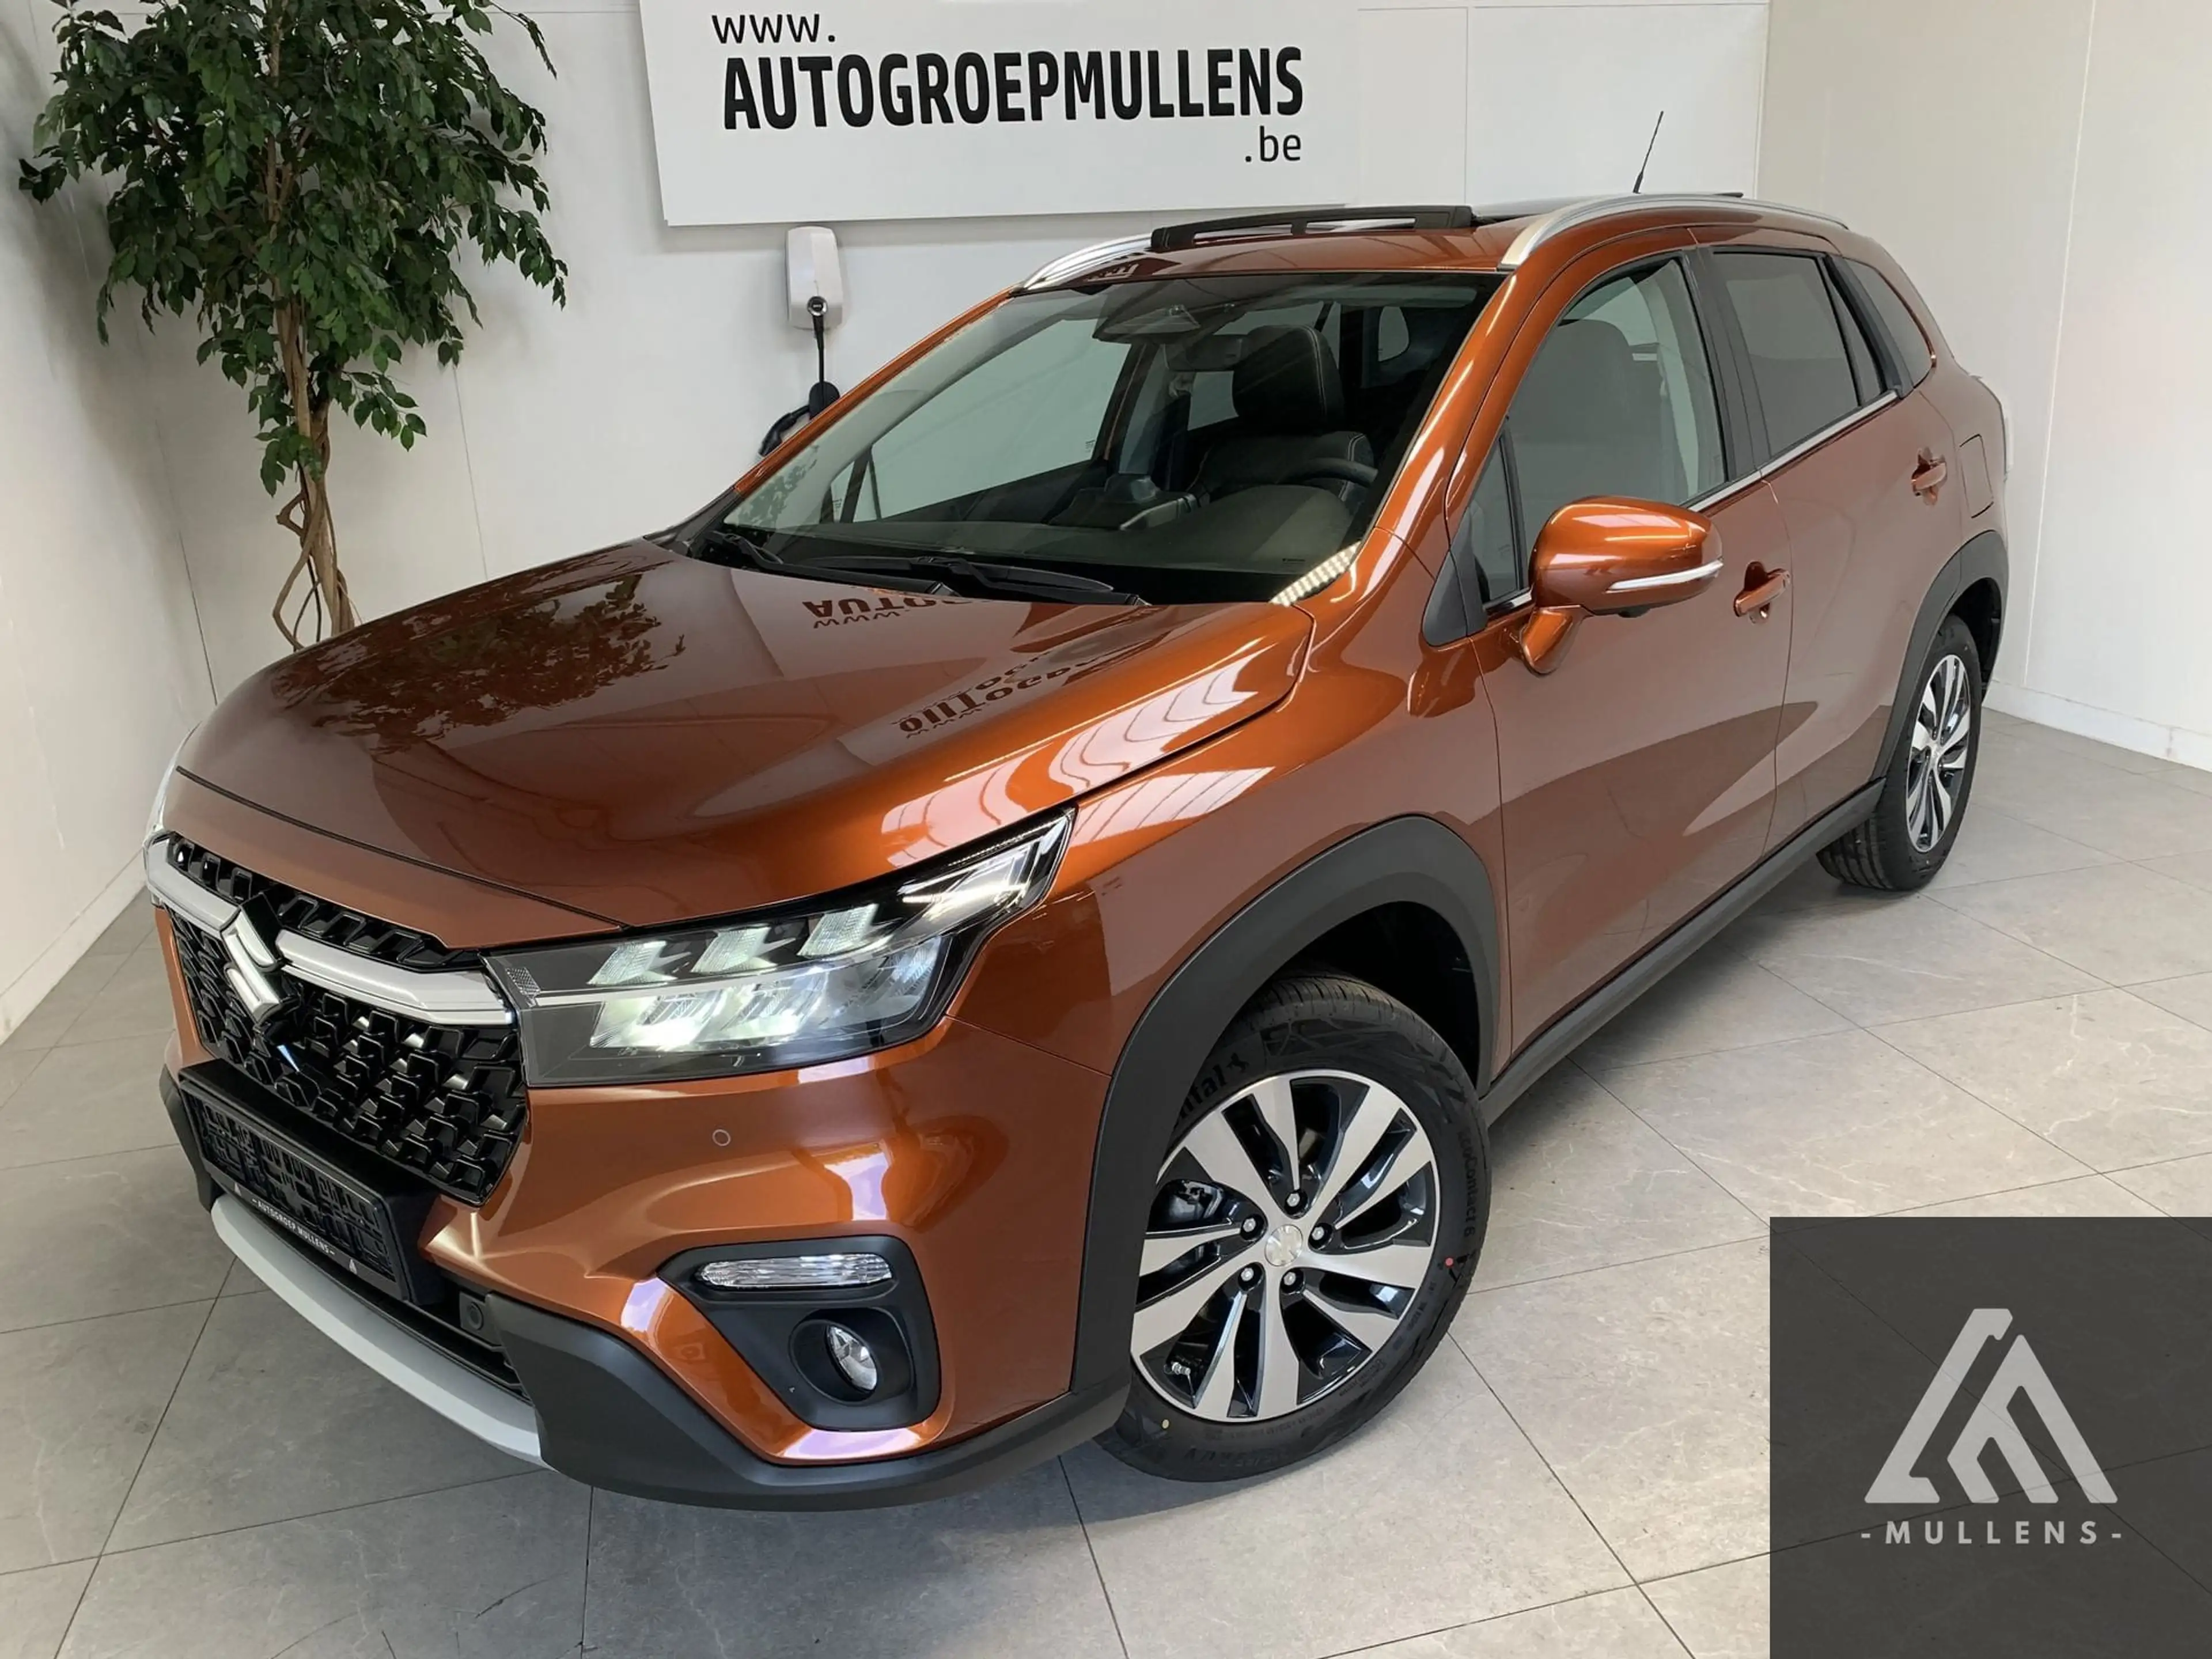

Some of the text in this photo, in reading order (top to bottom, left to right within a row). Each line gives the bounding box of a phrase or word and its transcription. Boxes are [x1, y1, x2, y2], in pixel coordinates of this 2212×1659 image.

[712, 14, 836, 44] www.
[724, 47, 1303, 130] AUTOGROEPMULLENS
[1244, 126, 1301, 162] .be
